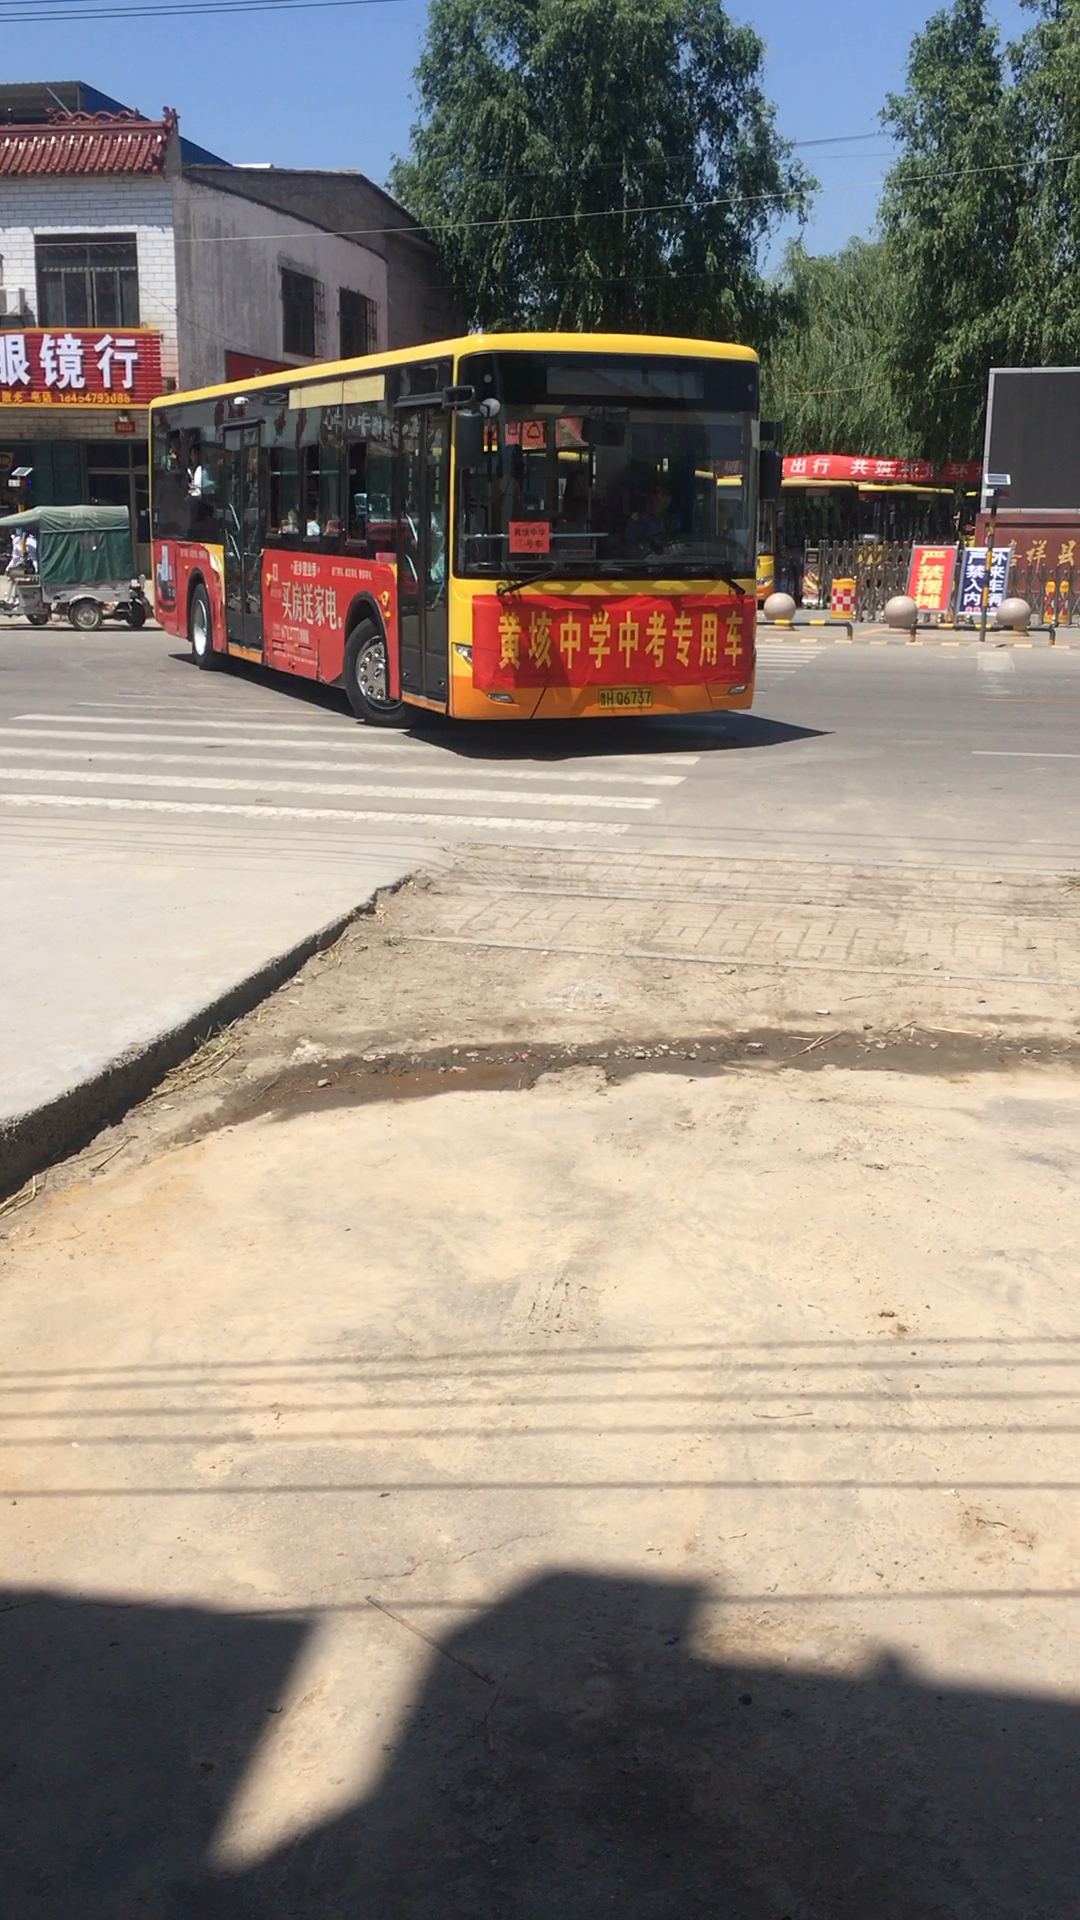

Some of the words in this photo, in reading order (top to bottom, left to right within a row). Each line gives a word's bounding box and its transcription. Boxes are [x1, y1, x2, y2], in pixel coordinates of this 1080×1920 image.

[0, 333, 138, 389] 眼镜行
[782, 458, 831, 475] 出行
[914, 550, 947, 609] 严禁摆摊
[963, 552, 988, 606] 严禁入内
[499, 611, 743, 669] 黄垓中学中考专用车
